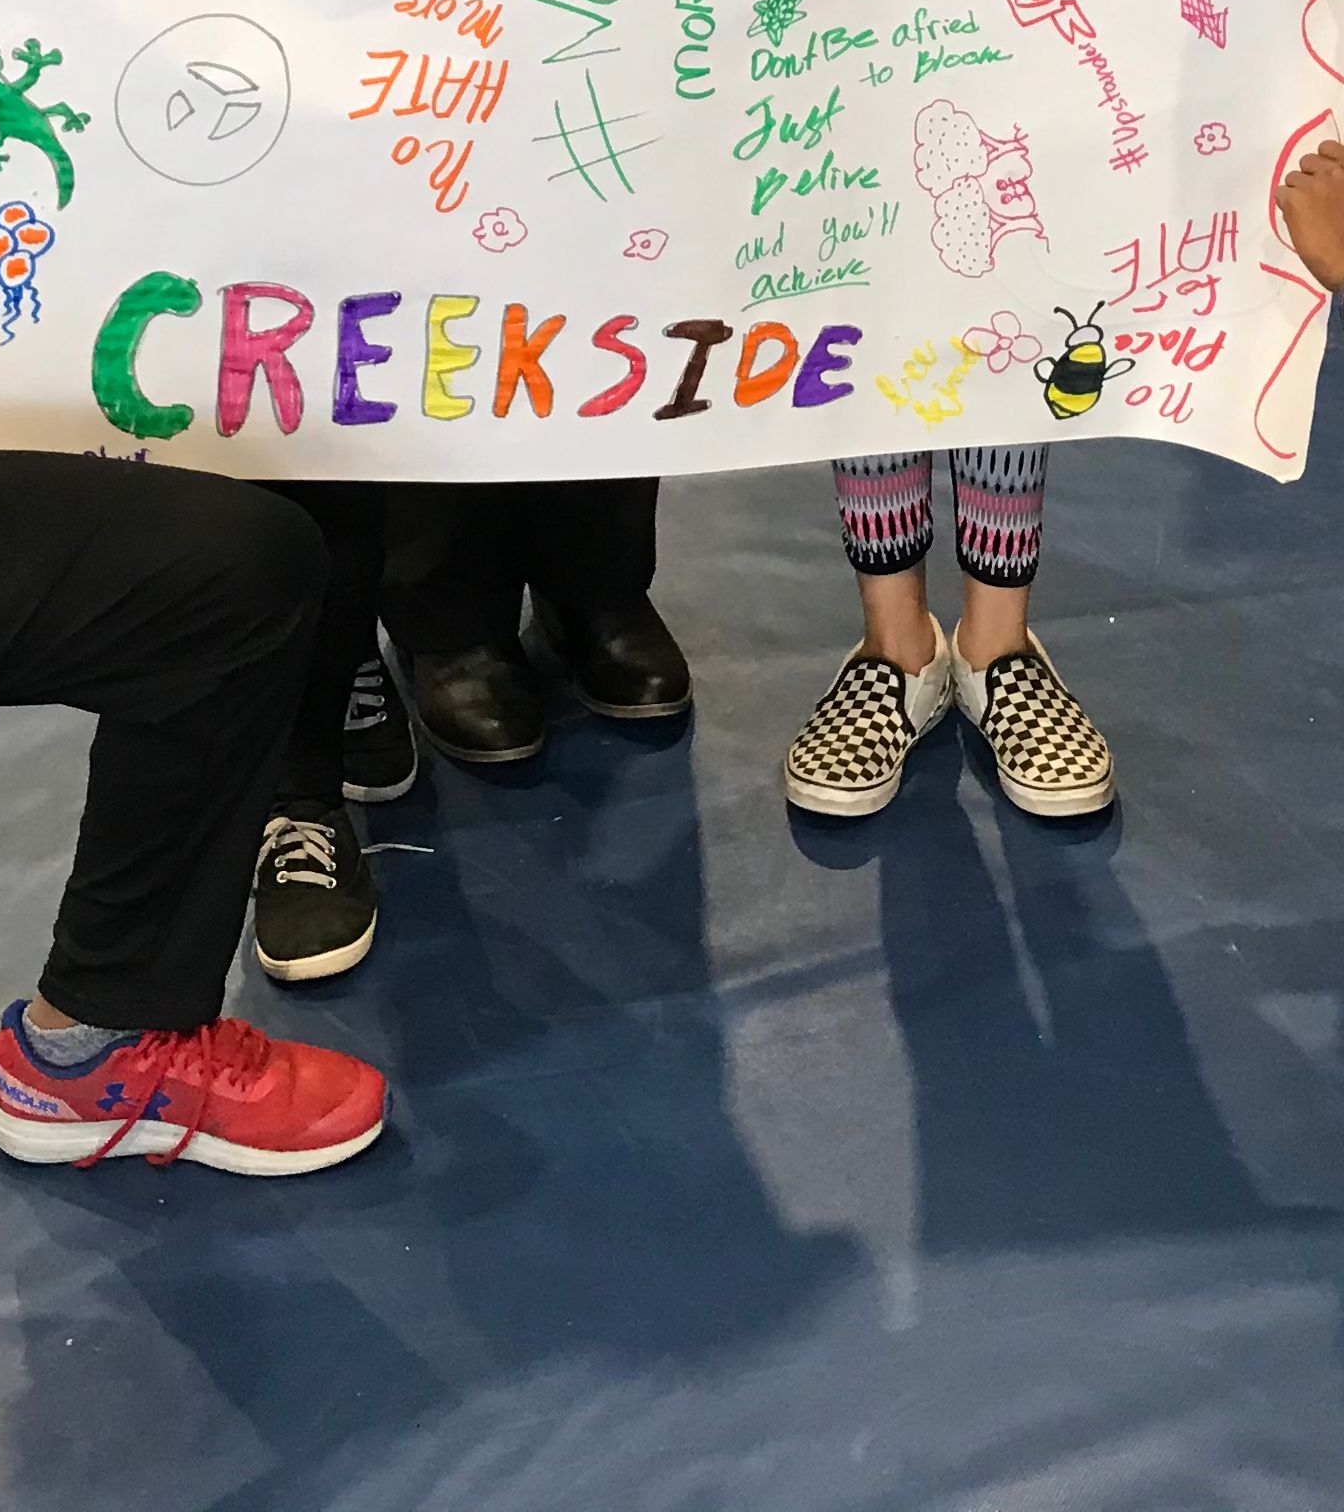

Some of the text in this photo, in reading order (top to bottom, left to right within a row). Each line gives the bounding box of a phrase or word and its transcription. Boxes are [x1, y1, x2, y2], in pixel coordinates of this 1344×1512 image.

[347, 49, 510, 125] HATE
[858, 62, 894, 87] to
[732, 85, 846, 161] Just
[734, 221, 785, 270] and
[750, 257, 873, 300] achieve
[1103, 209, 1240, 307] HATE
[91, 270, 864, 440] CREEKSIDE
